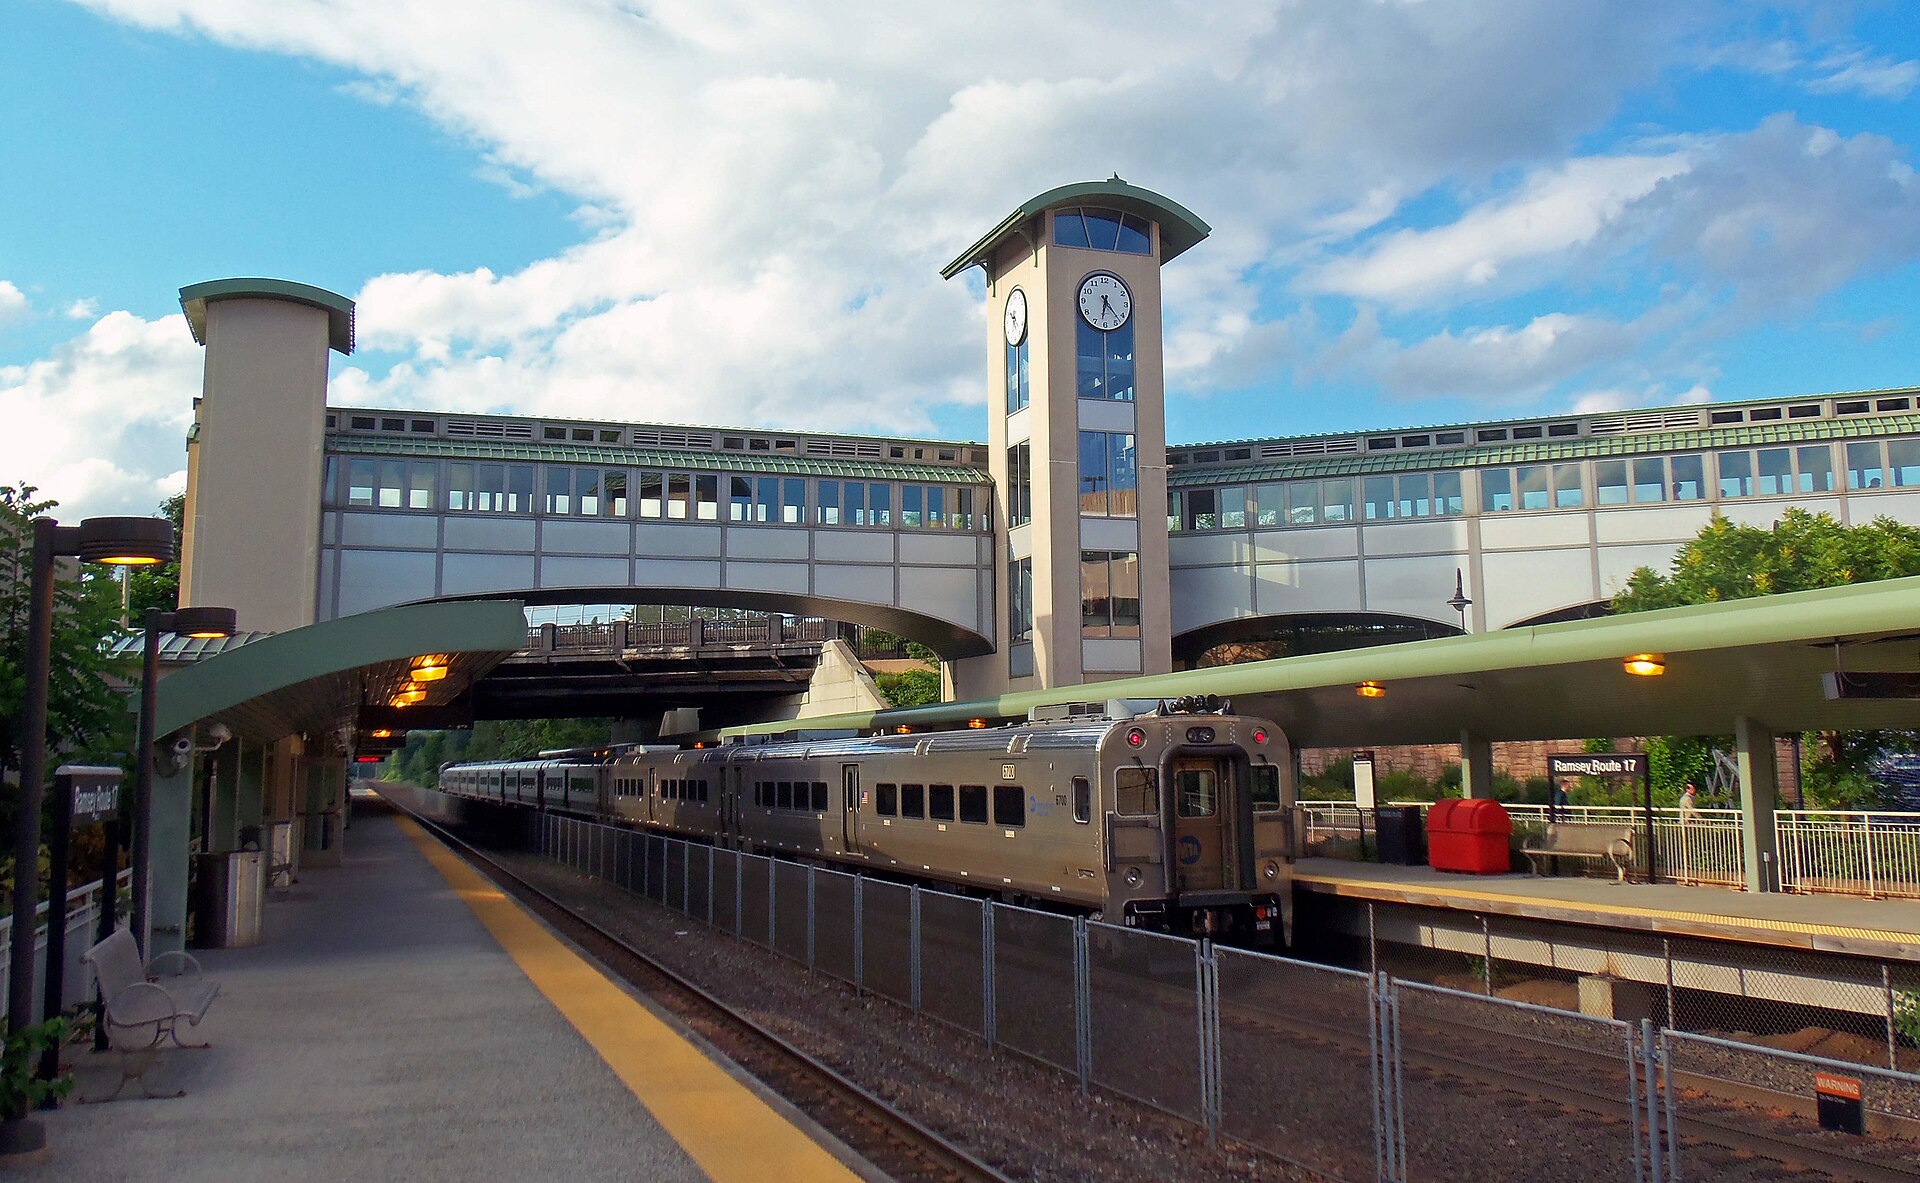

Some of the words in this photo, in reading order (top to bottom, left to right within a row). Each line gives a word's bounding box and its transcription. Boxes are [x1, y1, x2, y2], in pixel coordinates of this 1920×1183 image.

[1554, 760, 1591, 774] Ramsey
[1592, 760, 1622, 772] Route
[1623, 759, 1636, 771] 17
[1816, 1077, 1859, 1095] WARNING
